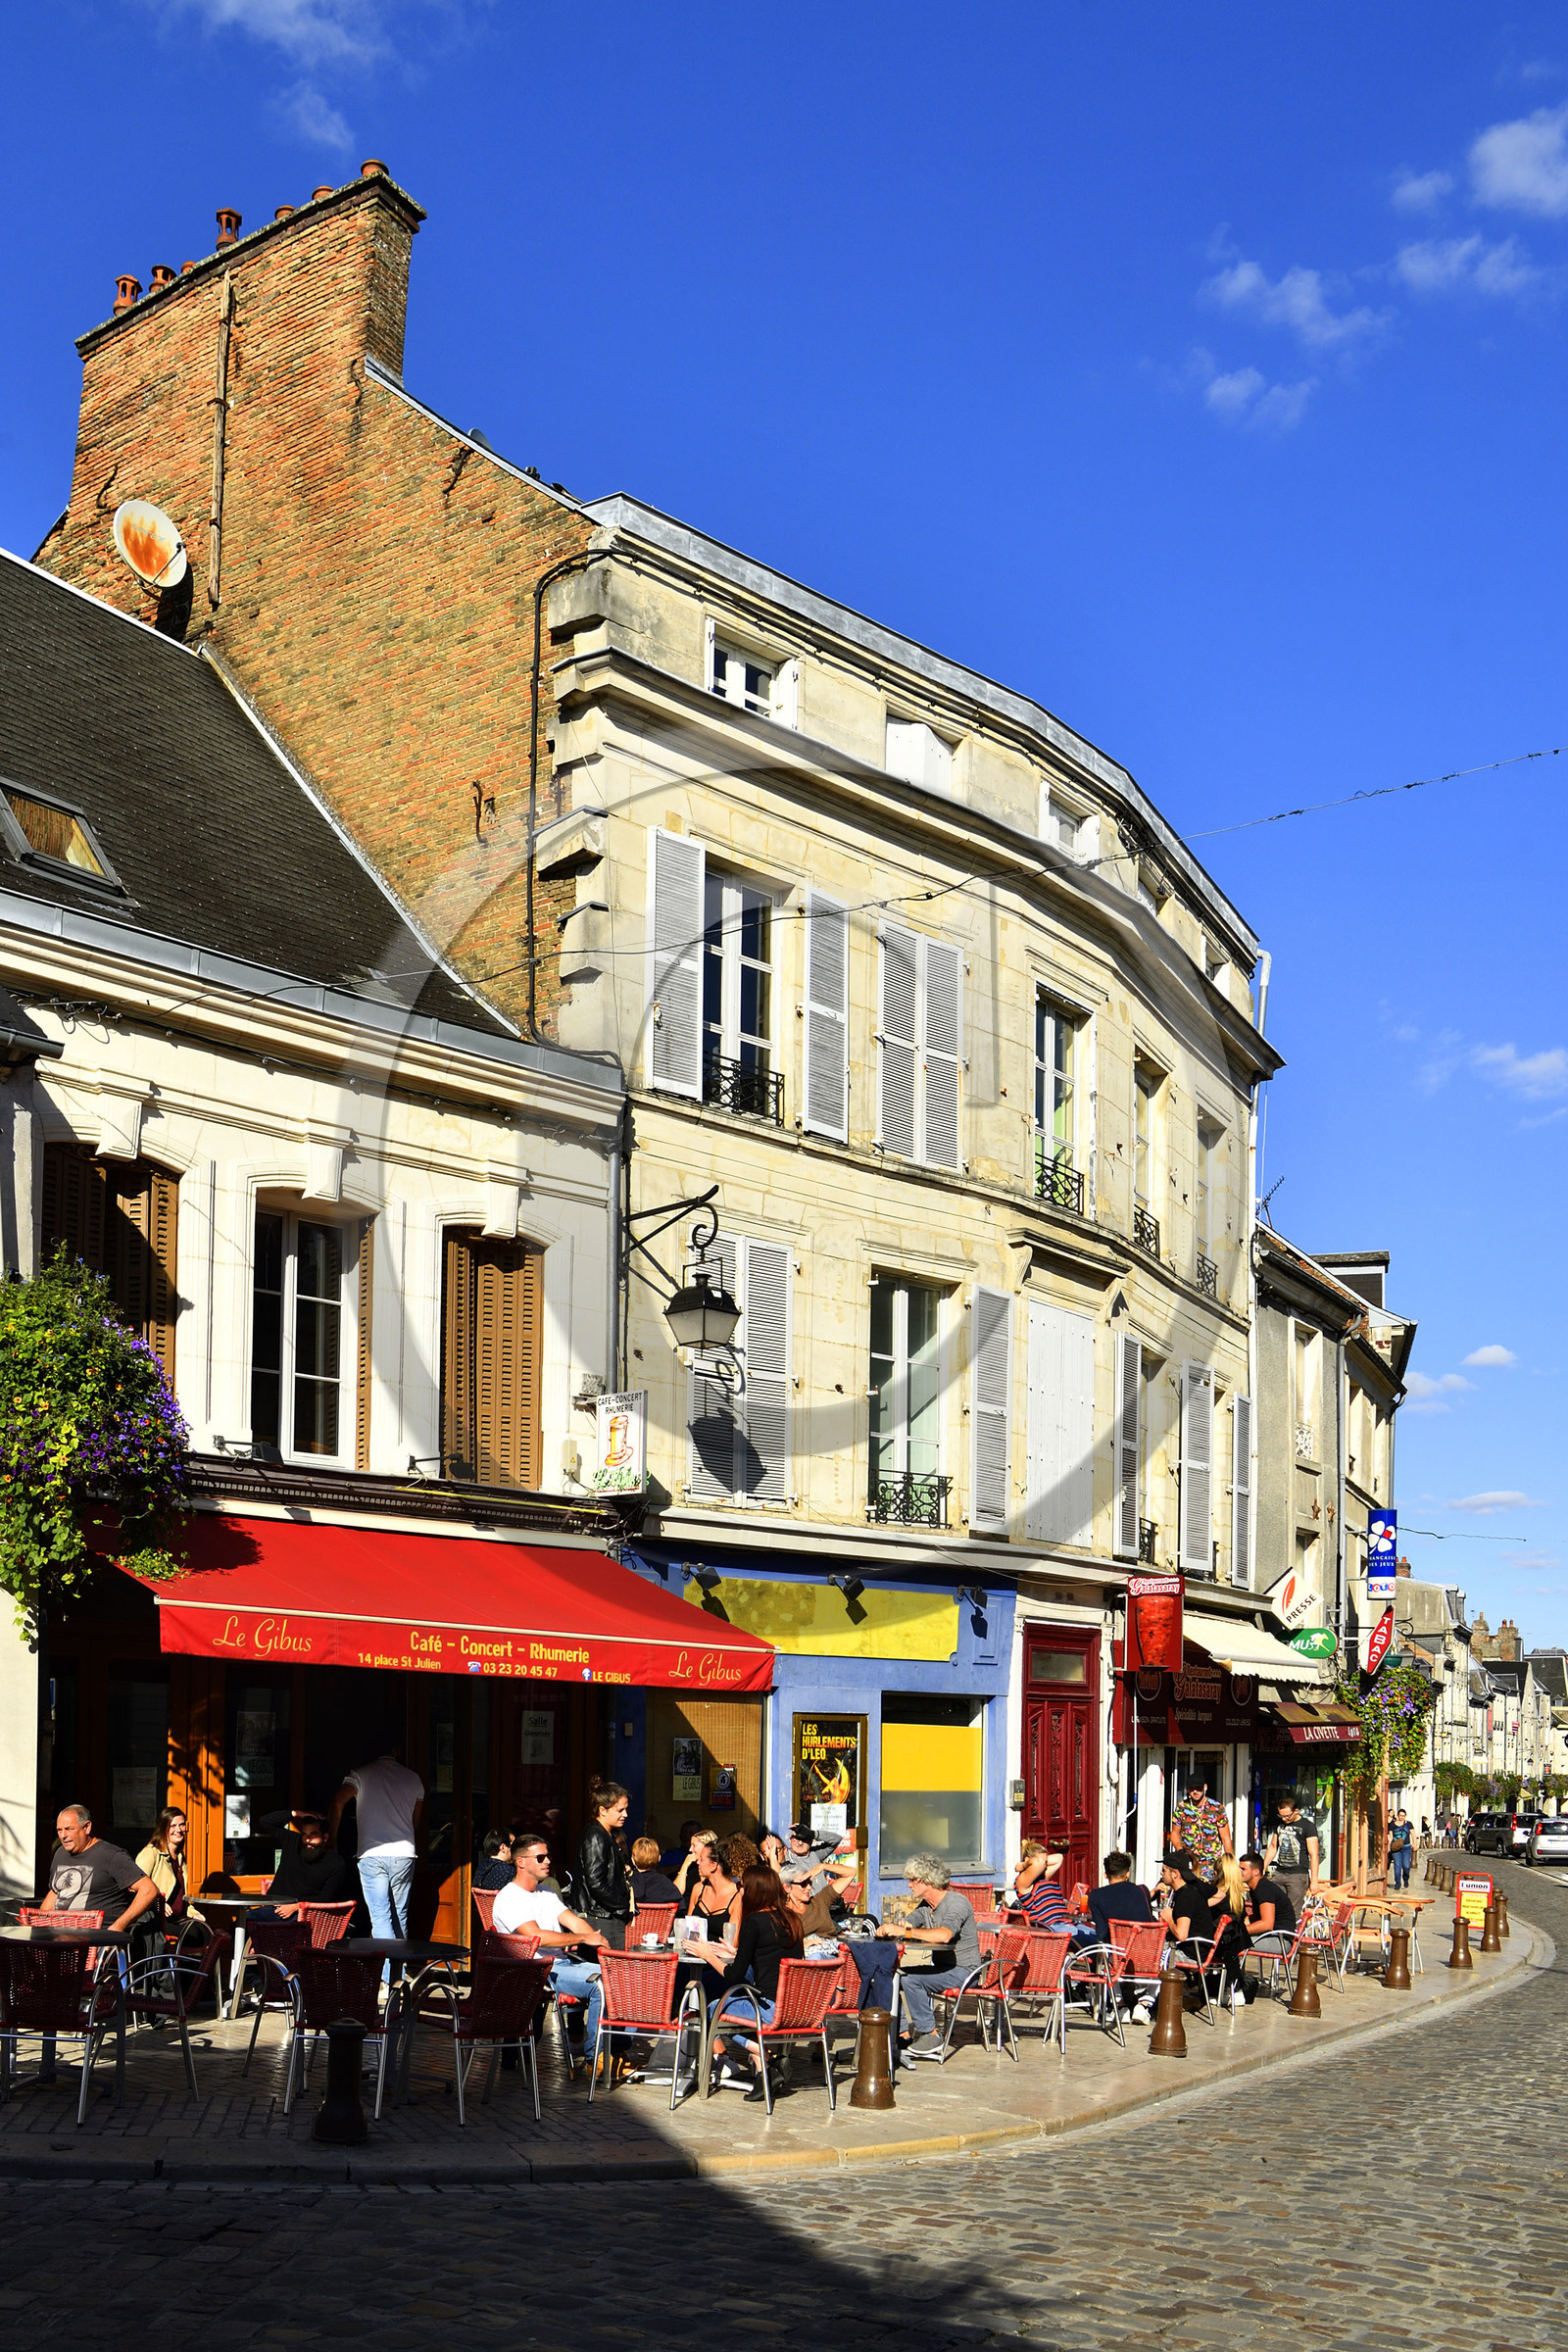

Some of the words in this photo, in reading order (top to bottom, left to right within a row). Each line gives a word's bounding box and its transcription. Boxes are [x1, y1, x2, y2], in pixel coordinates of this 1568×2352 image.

[605, 1403, 634, 1414] RHUMERIE
[1129, 1578, 1180, 1595] Galatasaray
[1286, 1593, 1317, 1623] PRESSE
[213, 1615, 246, 1647] Le
[254, 1618, 312, 1657] Gibus
[1369, 1617, 1391, 1663] TABAC
[411, 1631, 442, 1652] Café
[461, 1636, 513, 1657] Concert
[530, 1642, 590, 1664] Rhumerie
[358, 1652, 371, 1664] 14
[374, 1654, 399, 1668] place
[401, 1656, 413, 1668] St
[414, 1657, 441, 1670] Julien
[668, 1650, 693, 1678] Le
[699, 1652, 742, 1686] Gibus
[483, 1662, 496, 1674] 03
[499, 1663, 513, 1675] 23
[514, 1664, 527, 1676] 20
[529, 1666, 543, 1677] 45
[545, 1666, 558, 1678] 47
[593, 1671, 603, 1683] LE
[605, 1672, 631, 1684] GIBUS
[1173, 1663, 1222, 1704] Galatasaray
[528, 1717, 549, 1726] Salle
[803, 1723, 817, 1736] LES
[1303, 1727, 1314, 1740] LA
[1313, 1727, 1340, 1740] CIVETTE
[802, 1736, 857, 1748] HURLEMENTS
[802, 1747, 826, 1760] D'LEO
